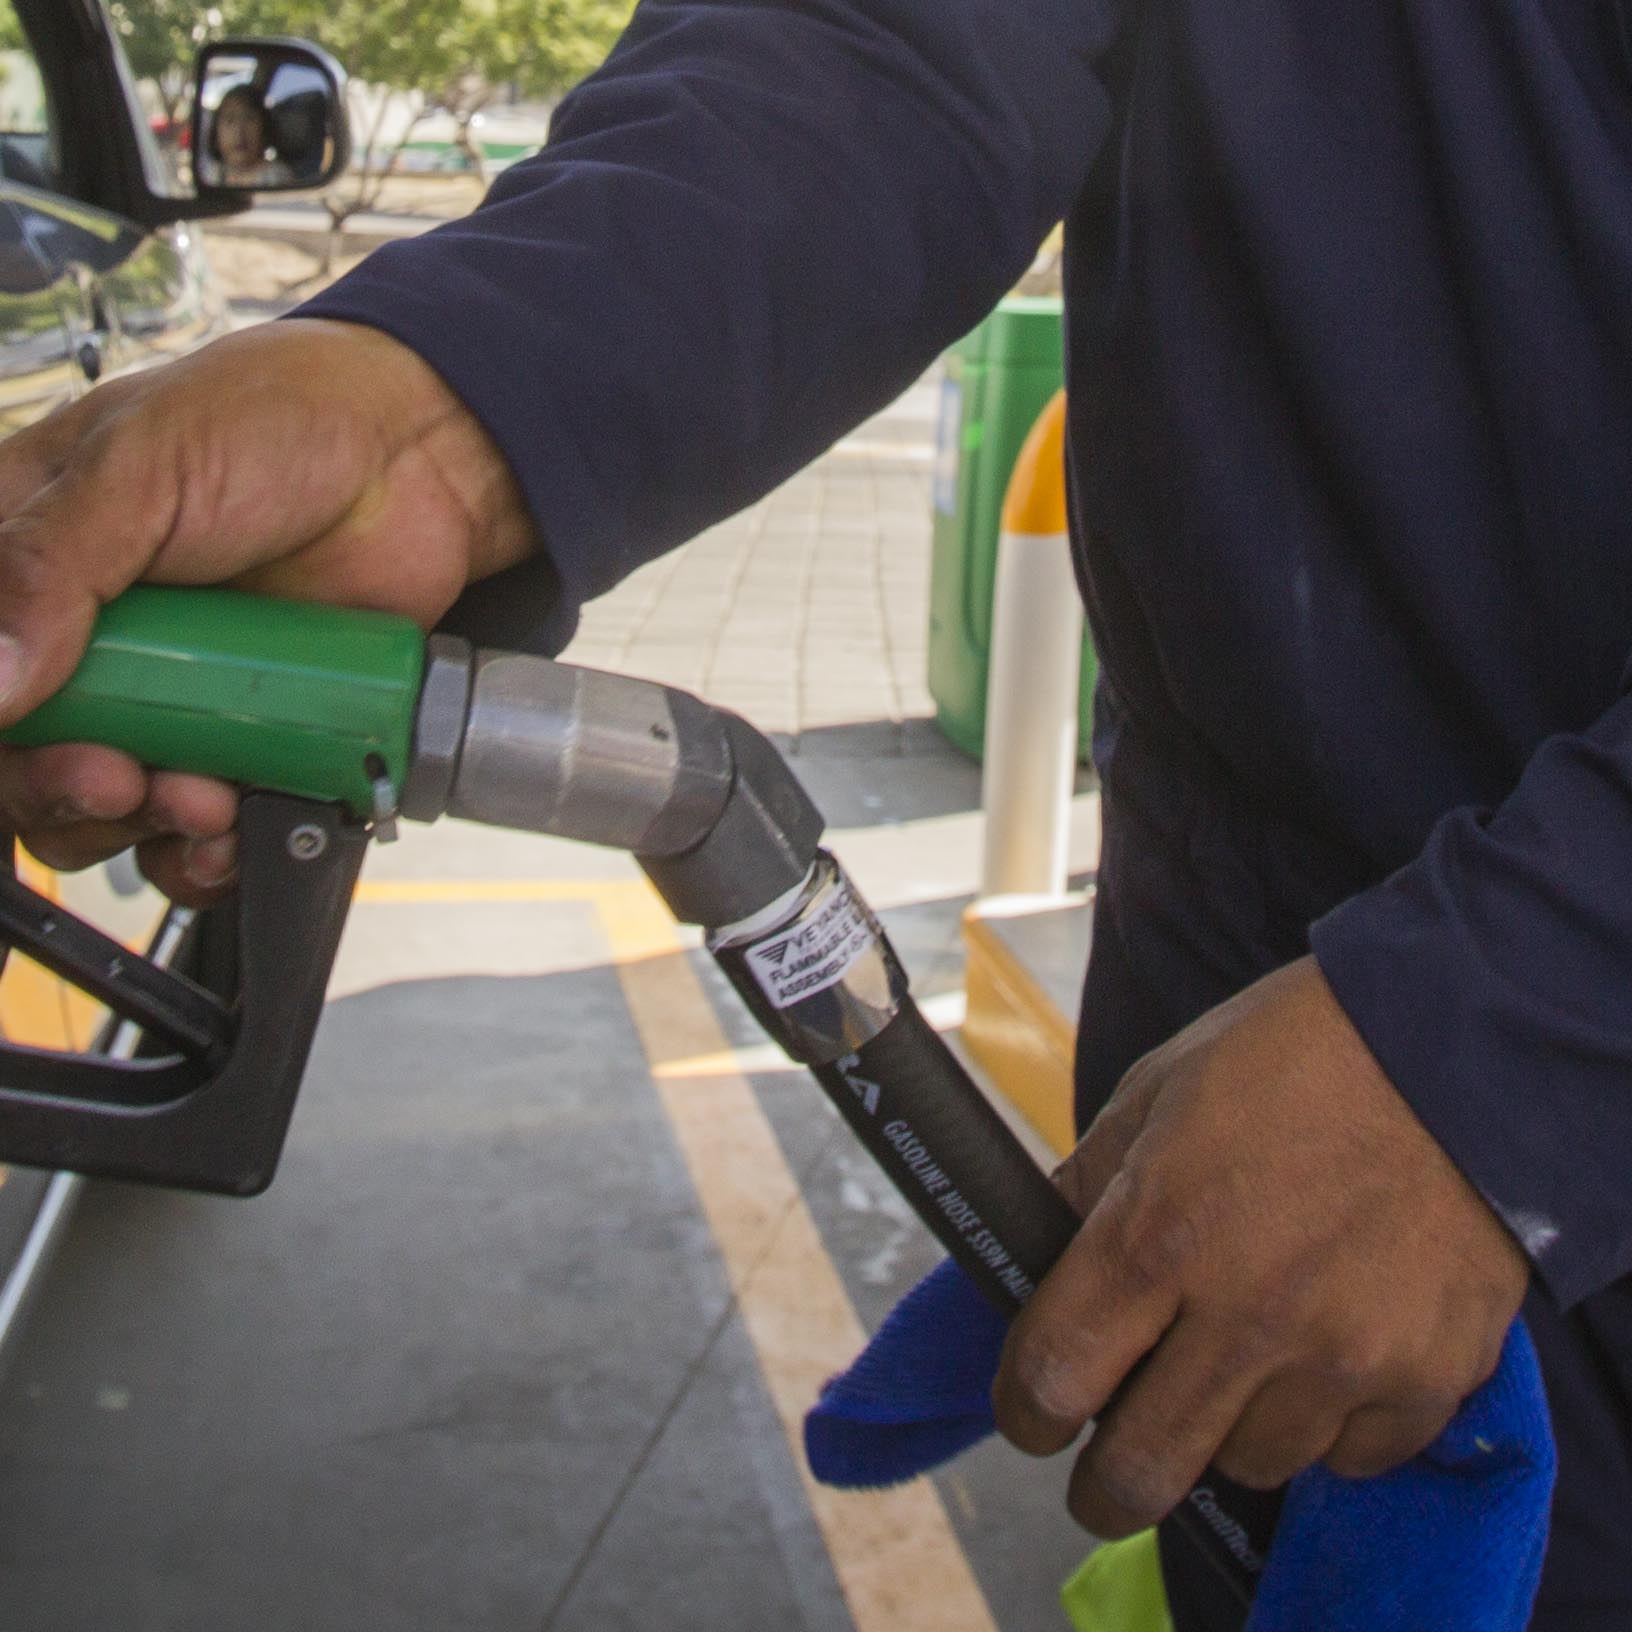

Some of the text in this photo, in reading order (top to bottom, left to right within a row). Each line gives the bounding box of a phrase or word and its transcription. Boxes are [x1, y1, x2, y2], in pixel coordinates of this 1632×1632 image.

[769, 920, 852, 984] FLAMMABLE
[882, 1119, 952, 1195] GASOLINE
[936, 1189, 983, 1234] HOSE
[997, 1264, 1037, 1302] MAD
